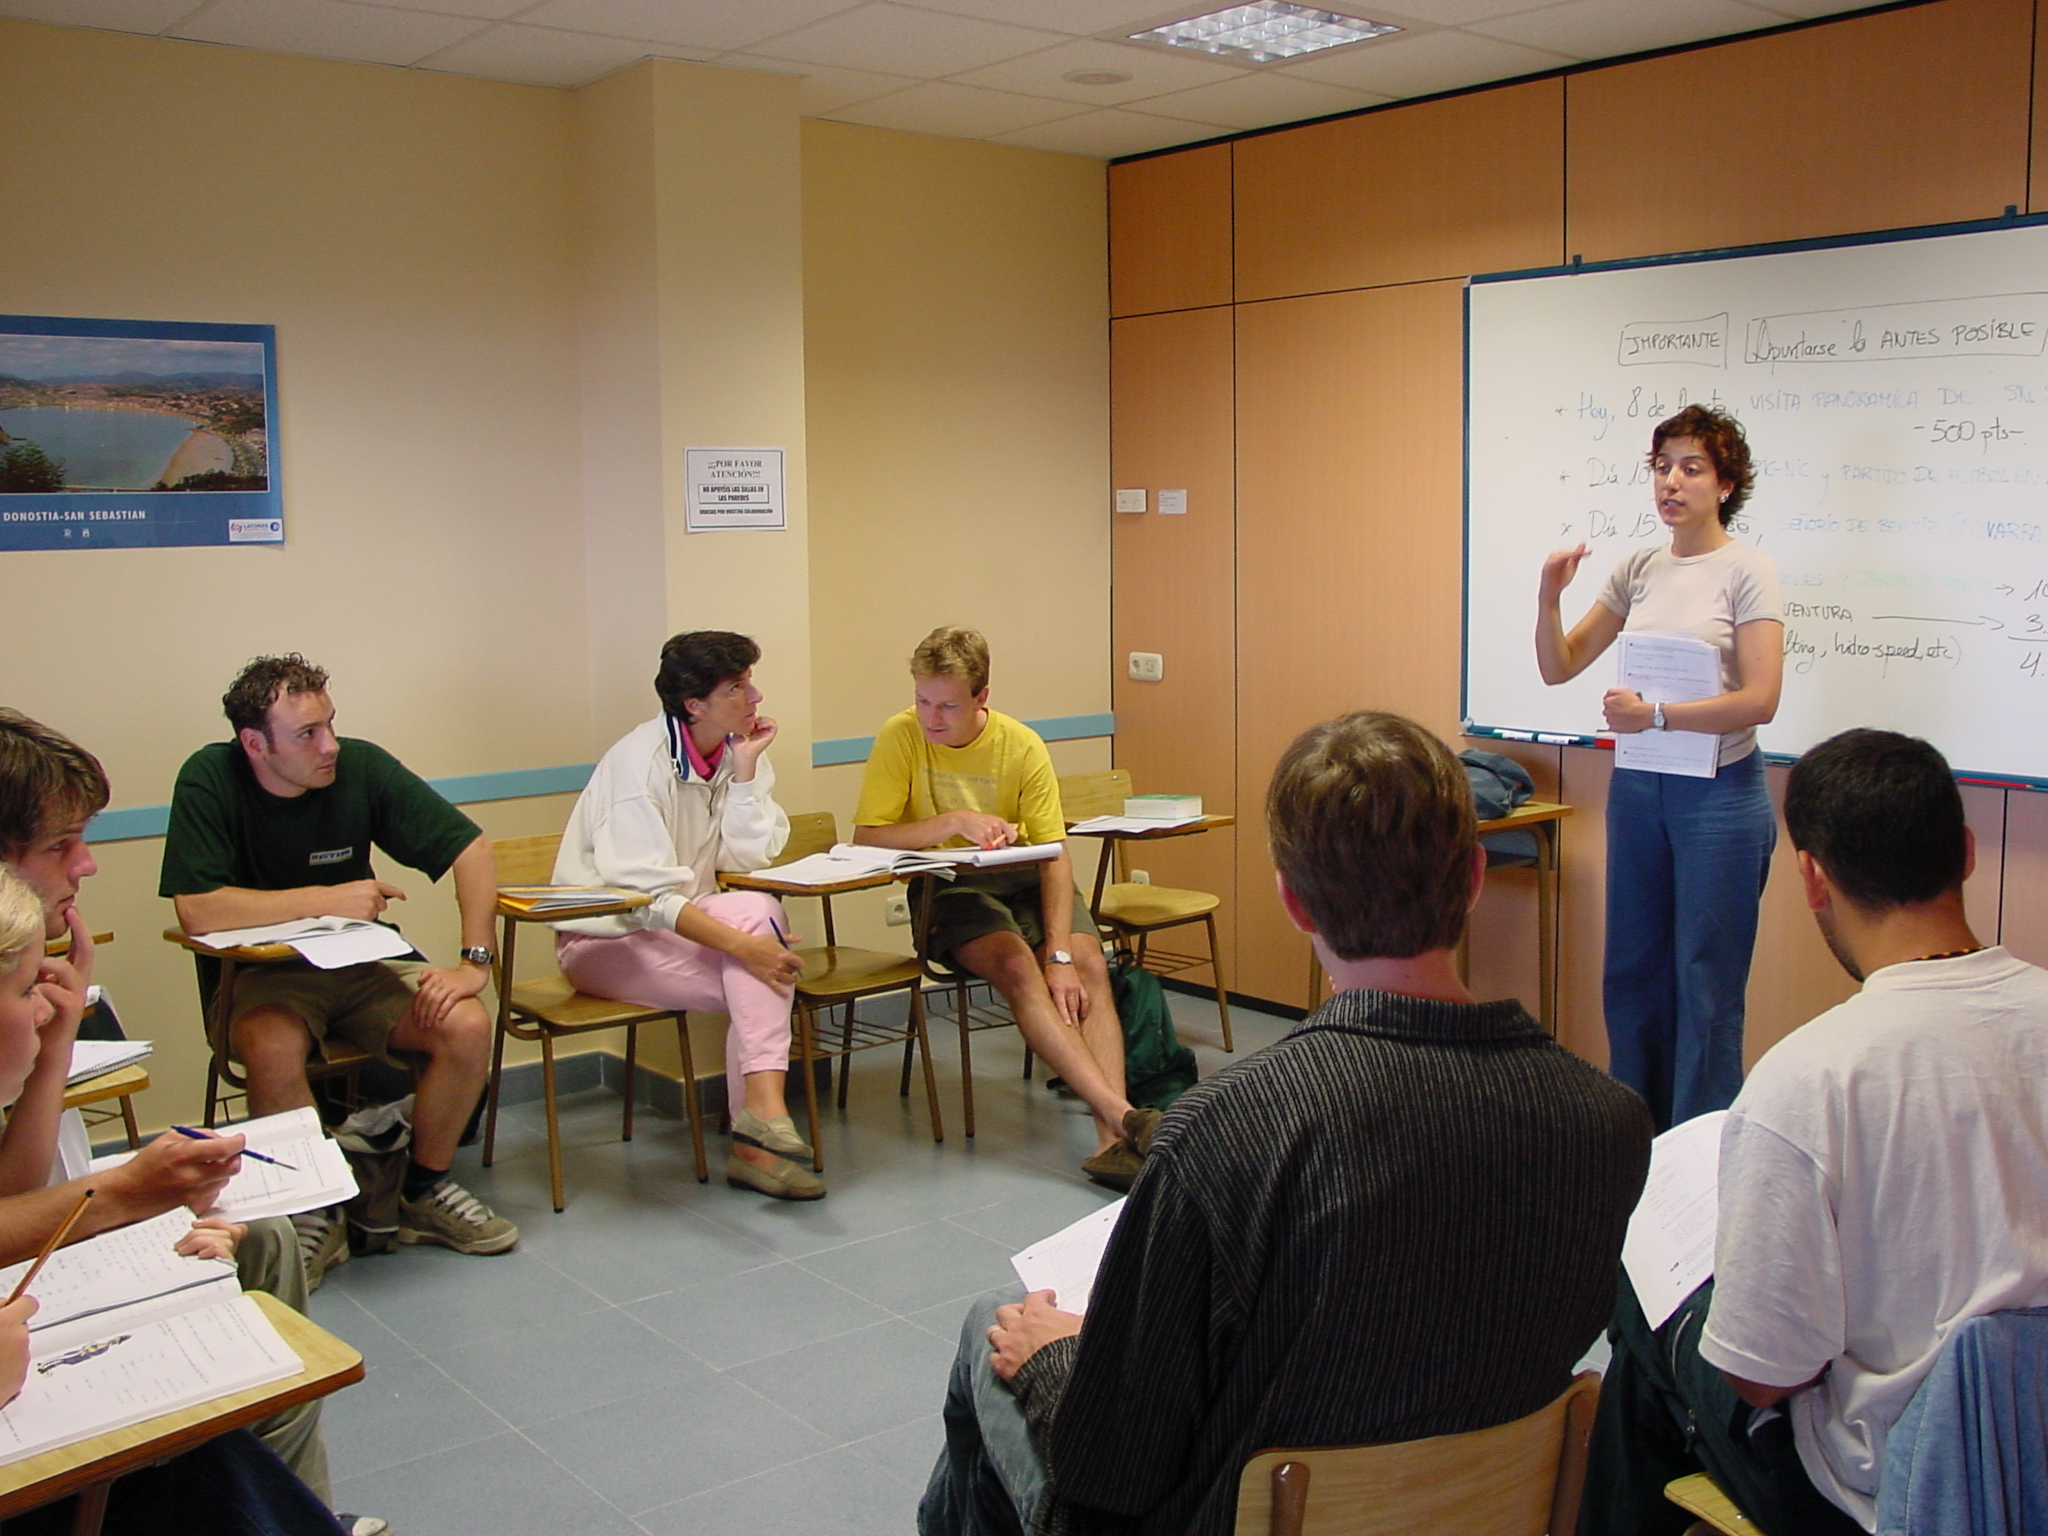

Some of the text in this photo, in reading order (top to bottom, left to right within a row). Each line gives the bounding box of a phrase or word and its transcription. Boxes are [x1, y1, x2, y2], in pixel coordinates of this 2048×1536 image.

[1625, 332, 1721, 356] IMPORTANTE
[1880, 328, 1941, 349] ANTES
[1626, 386, 1642, 418] 8
[1647, 392, 1665, 417] de
[734, 459, 762, 468] FAVOR
[3, 510, 146, 522] DONOSTIA-SAN SEBASTIAN
[1628, 512, 1658, 538] 15
